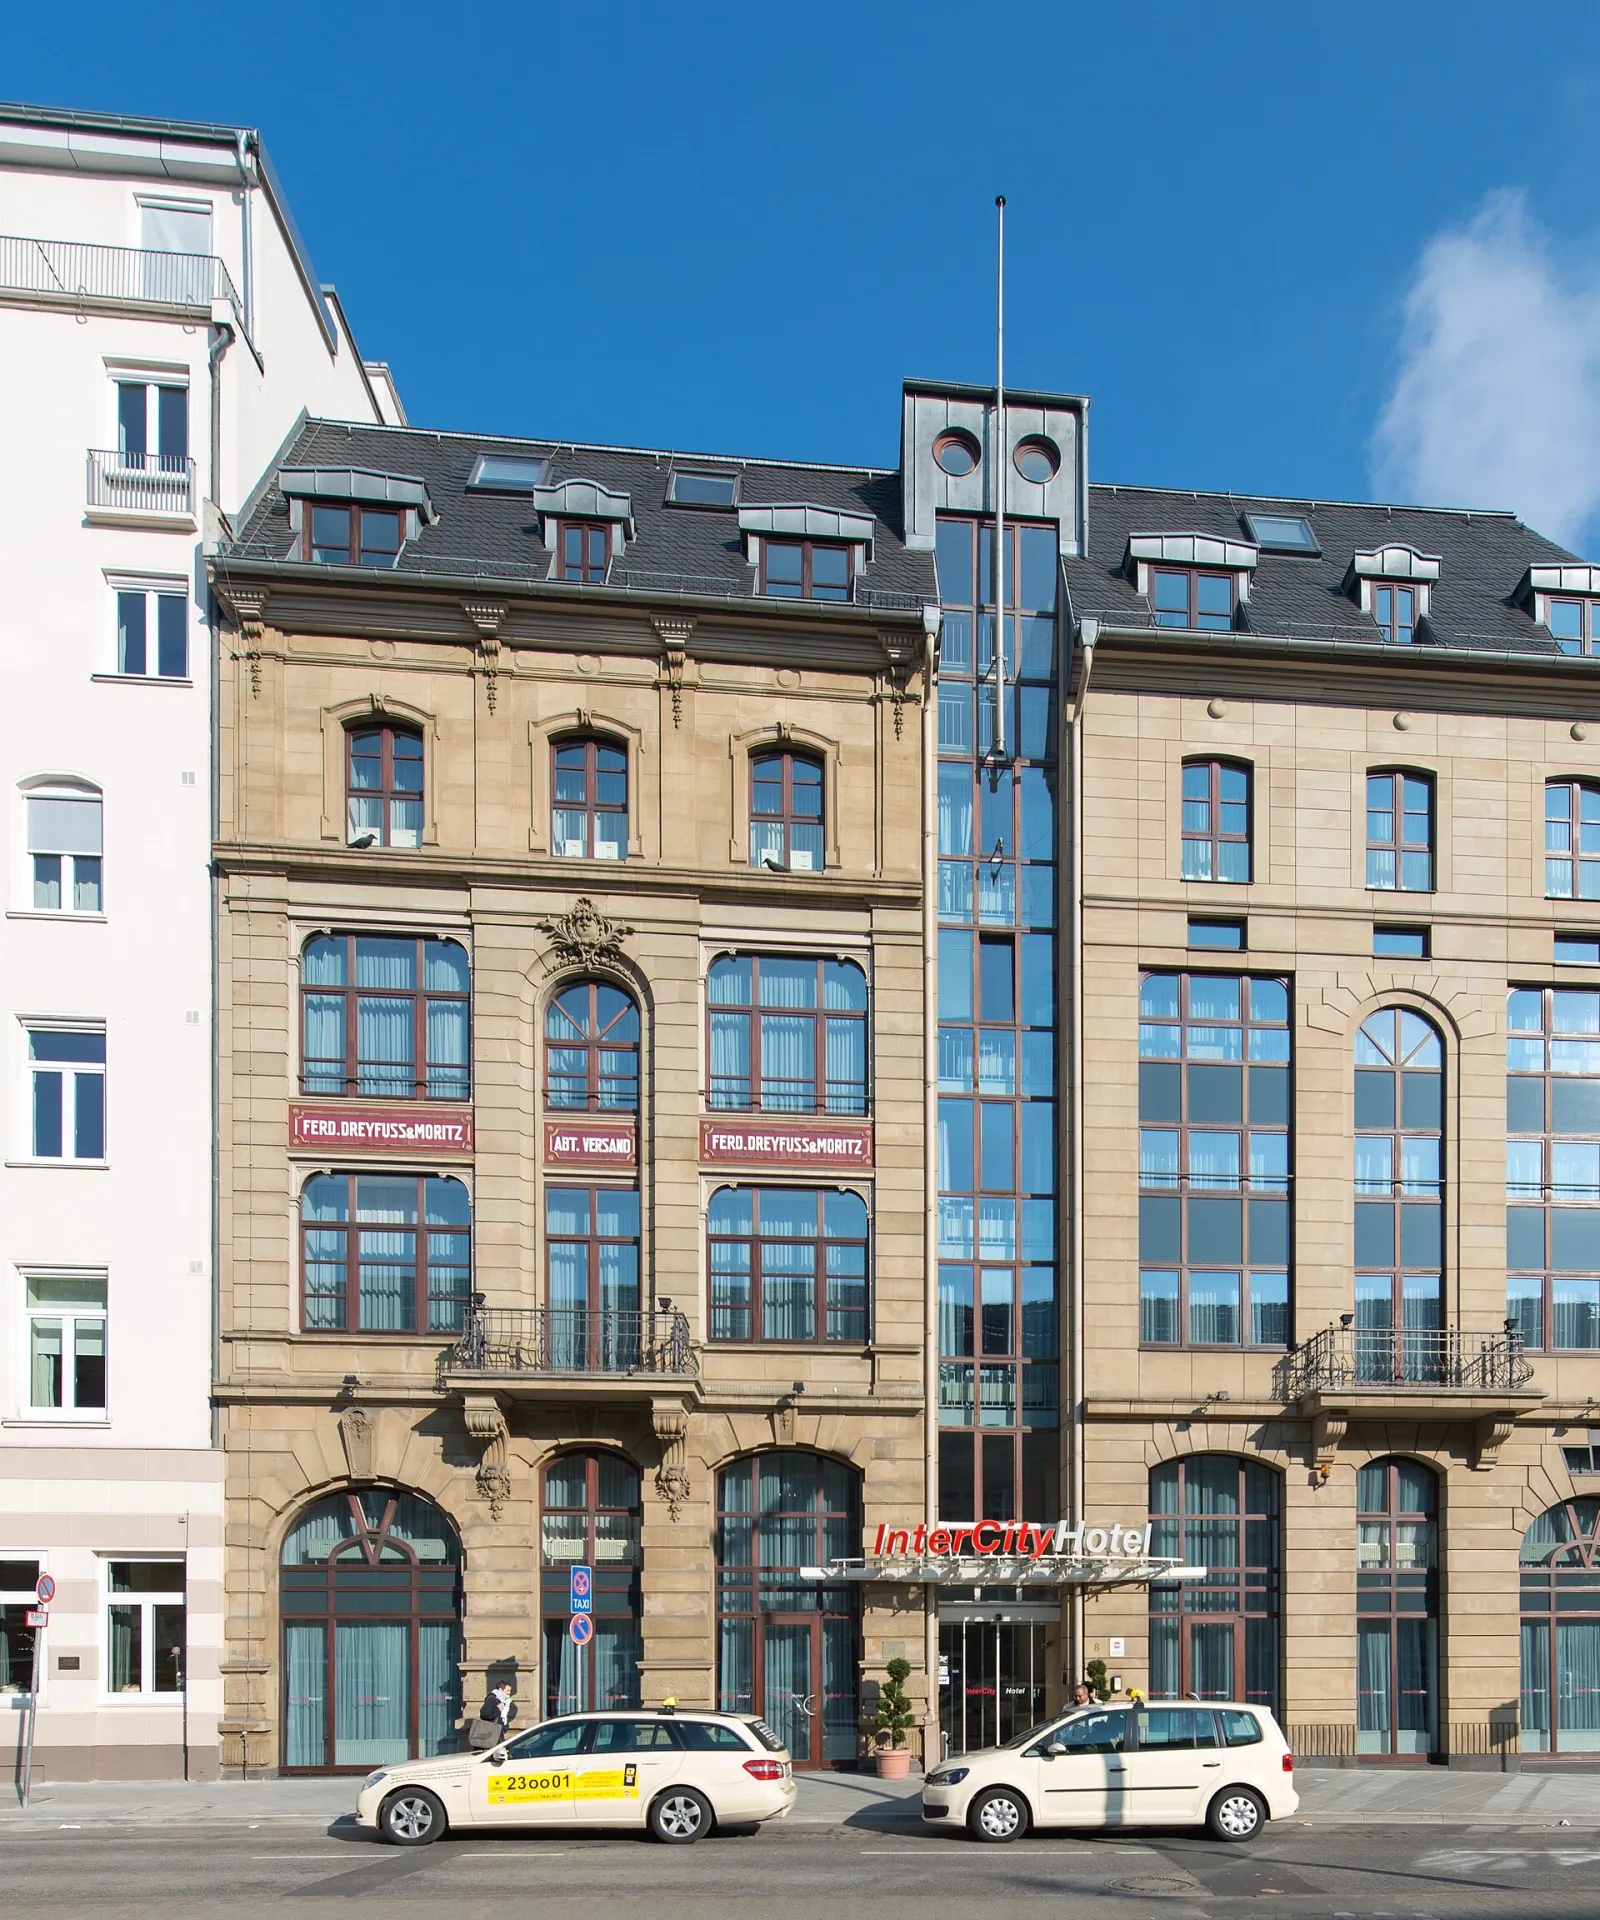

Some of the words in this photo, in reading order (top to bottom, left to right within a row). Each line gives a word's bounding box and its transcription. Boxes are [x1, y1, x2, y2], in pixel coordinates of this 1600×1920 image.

[554, 1136, 580, 1152] ABT.
[582, 1136, 631, 1154] VERSAND
[873, 1519, 1153, 1559] InterCityHotel
[573, 1598, 590, 1609] TAXI
[1005, 1687, 1026, 1695] Hotel
